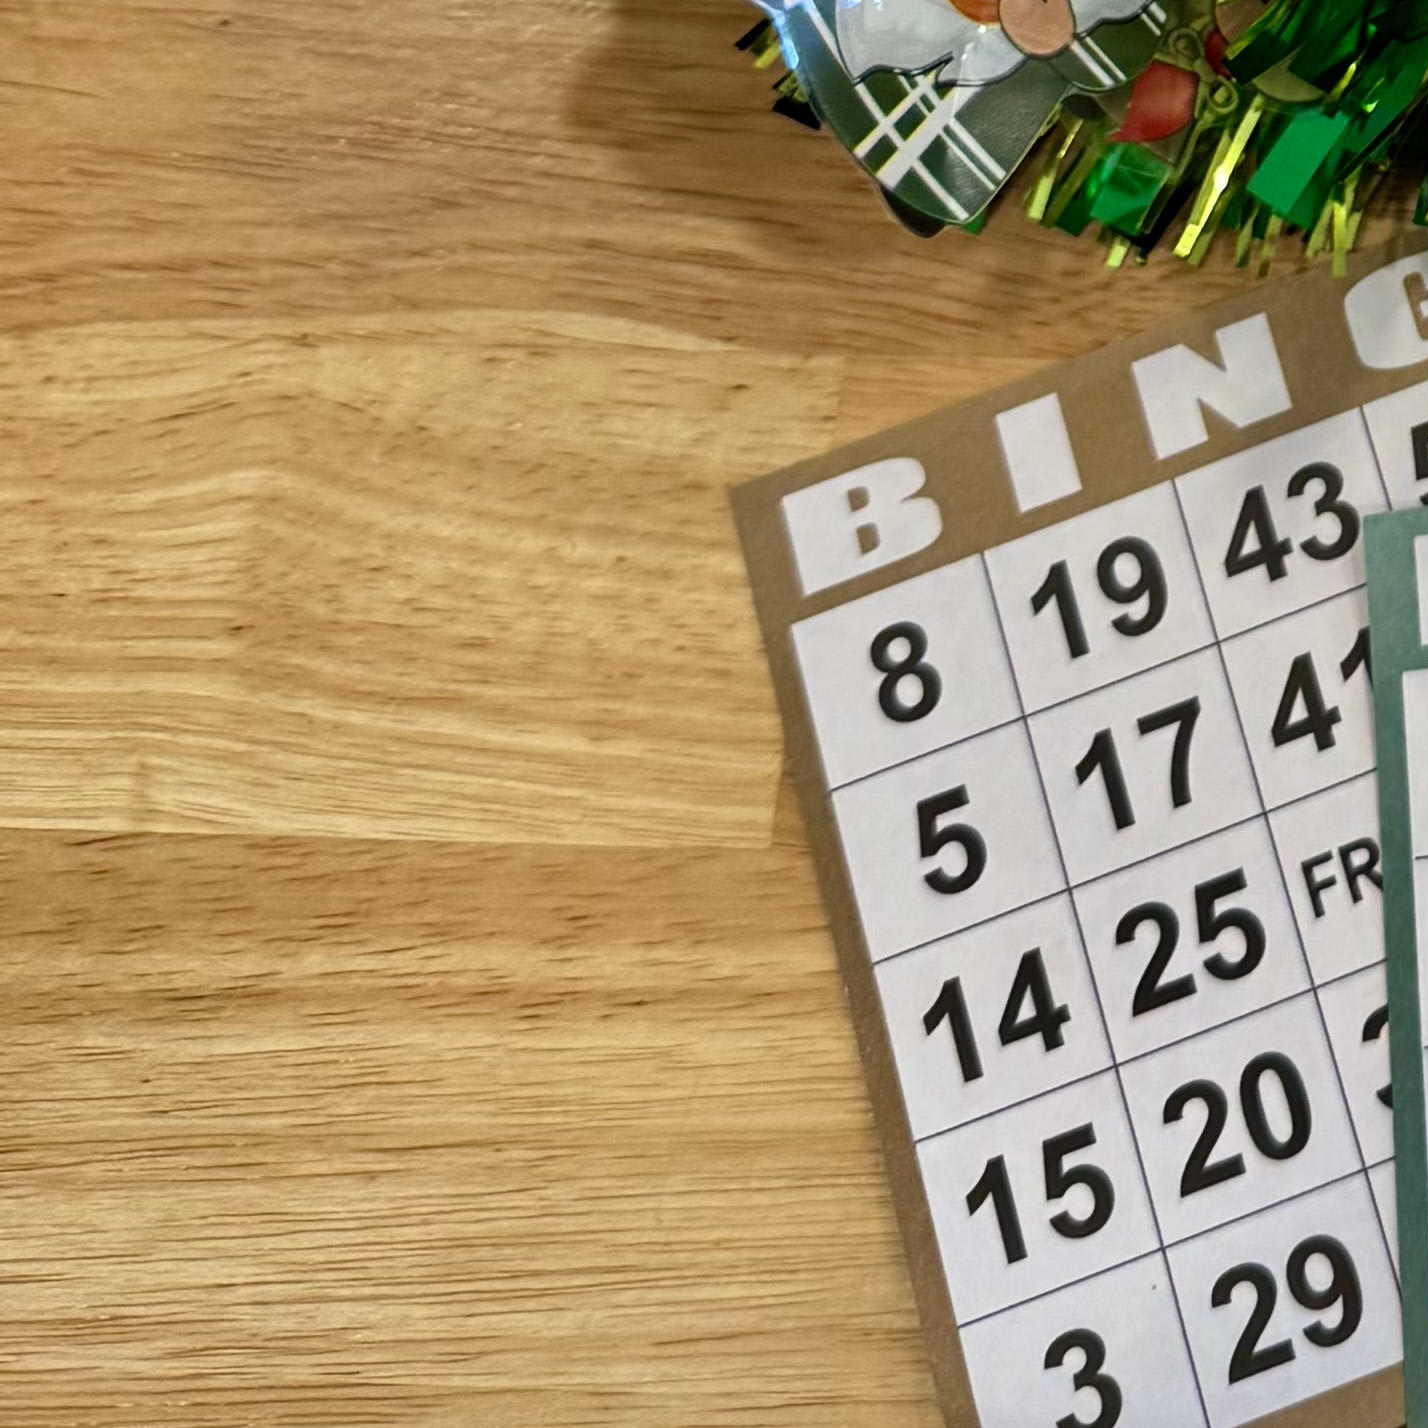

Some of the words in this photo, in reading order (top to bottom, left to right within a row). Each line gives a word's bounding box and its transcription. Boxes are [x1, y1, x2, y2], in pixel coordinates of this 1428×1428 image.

[870, 621, 942, 724] 8
[1030, 536, 1168, 660] 19
[1224, 462, 1361, 582] 43
[916, 785, 987, 895] 5
[1075, 696, 1201, 832] 17
[922, 947, 1072, 1083] 14
[1115, 867, 1267, 1018] 25
[1300, 837, 1384, 919] FR
[966, 1122, 1115, 1265] 15
[1162, 1051, 1313, 1198] 20
[1043, 1328, 1122, 1428] 3
[1211, 1234, 1364, 1386] 29
